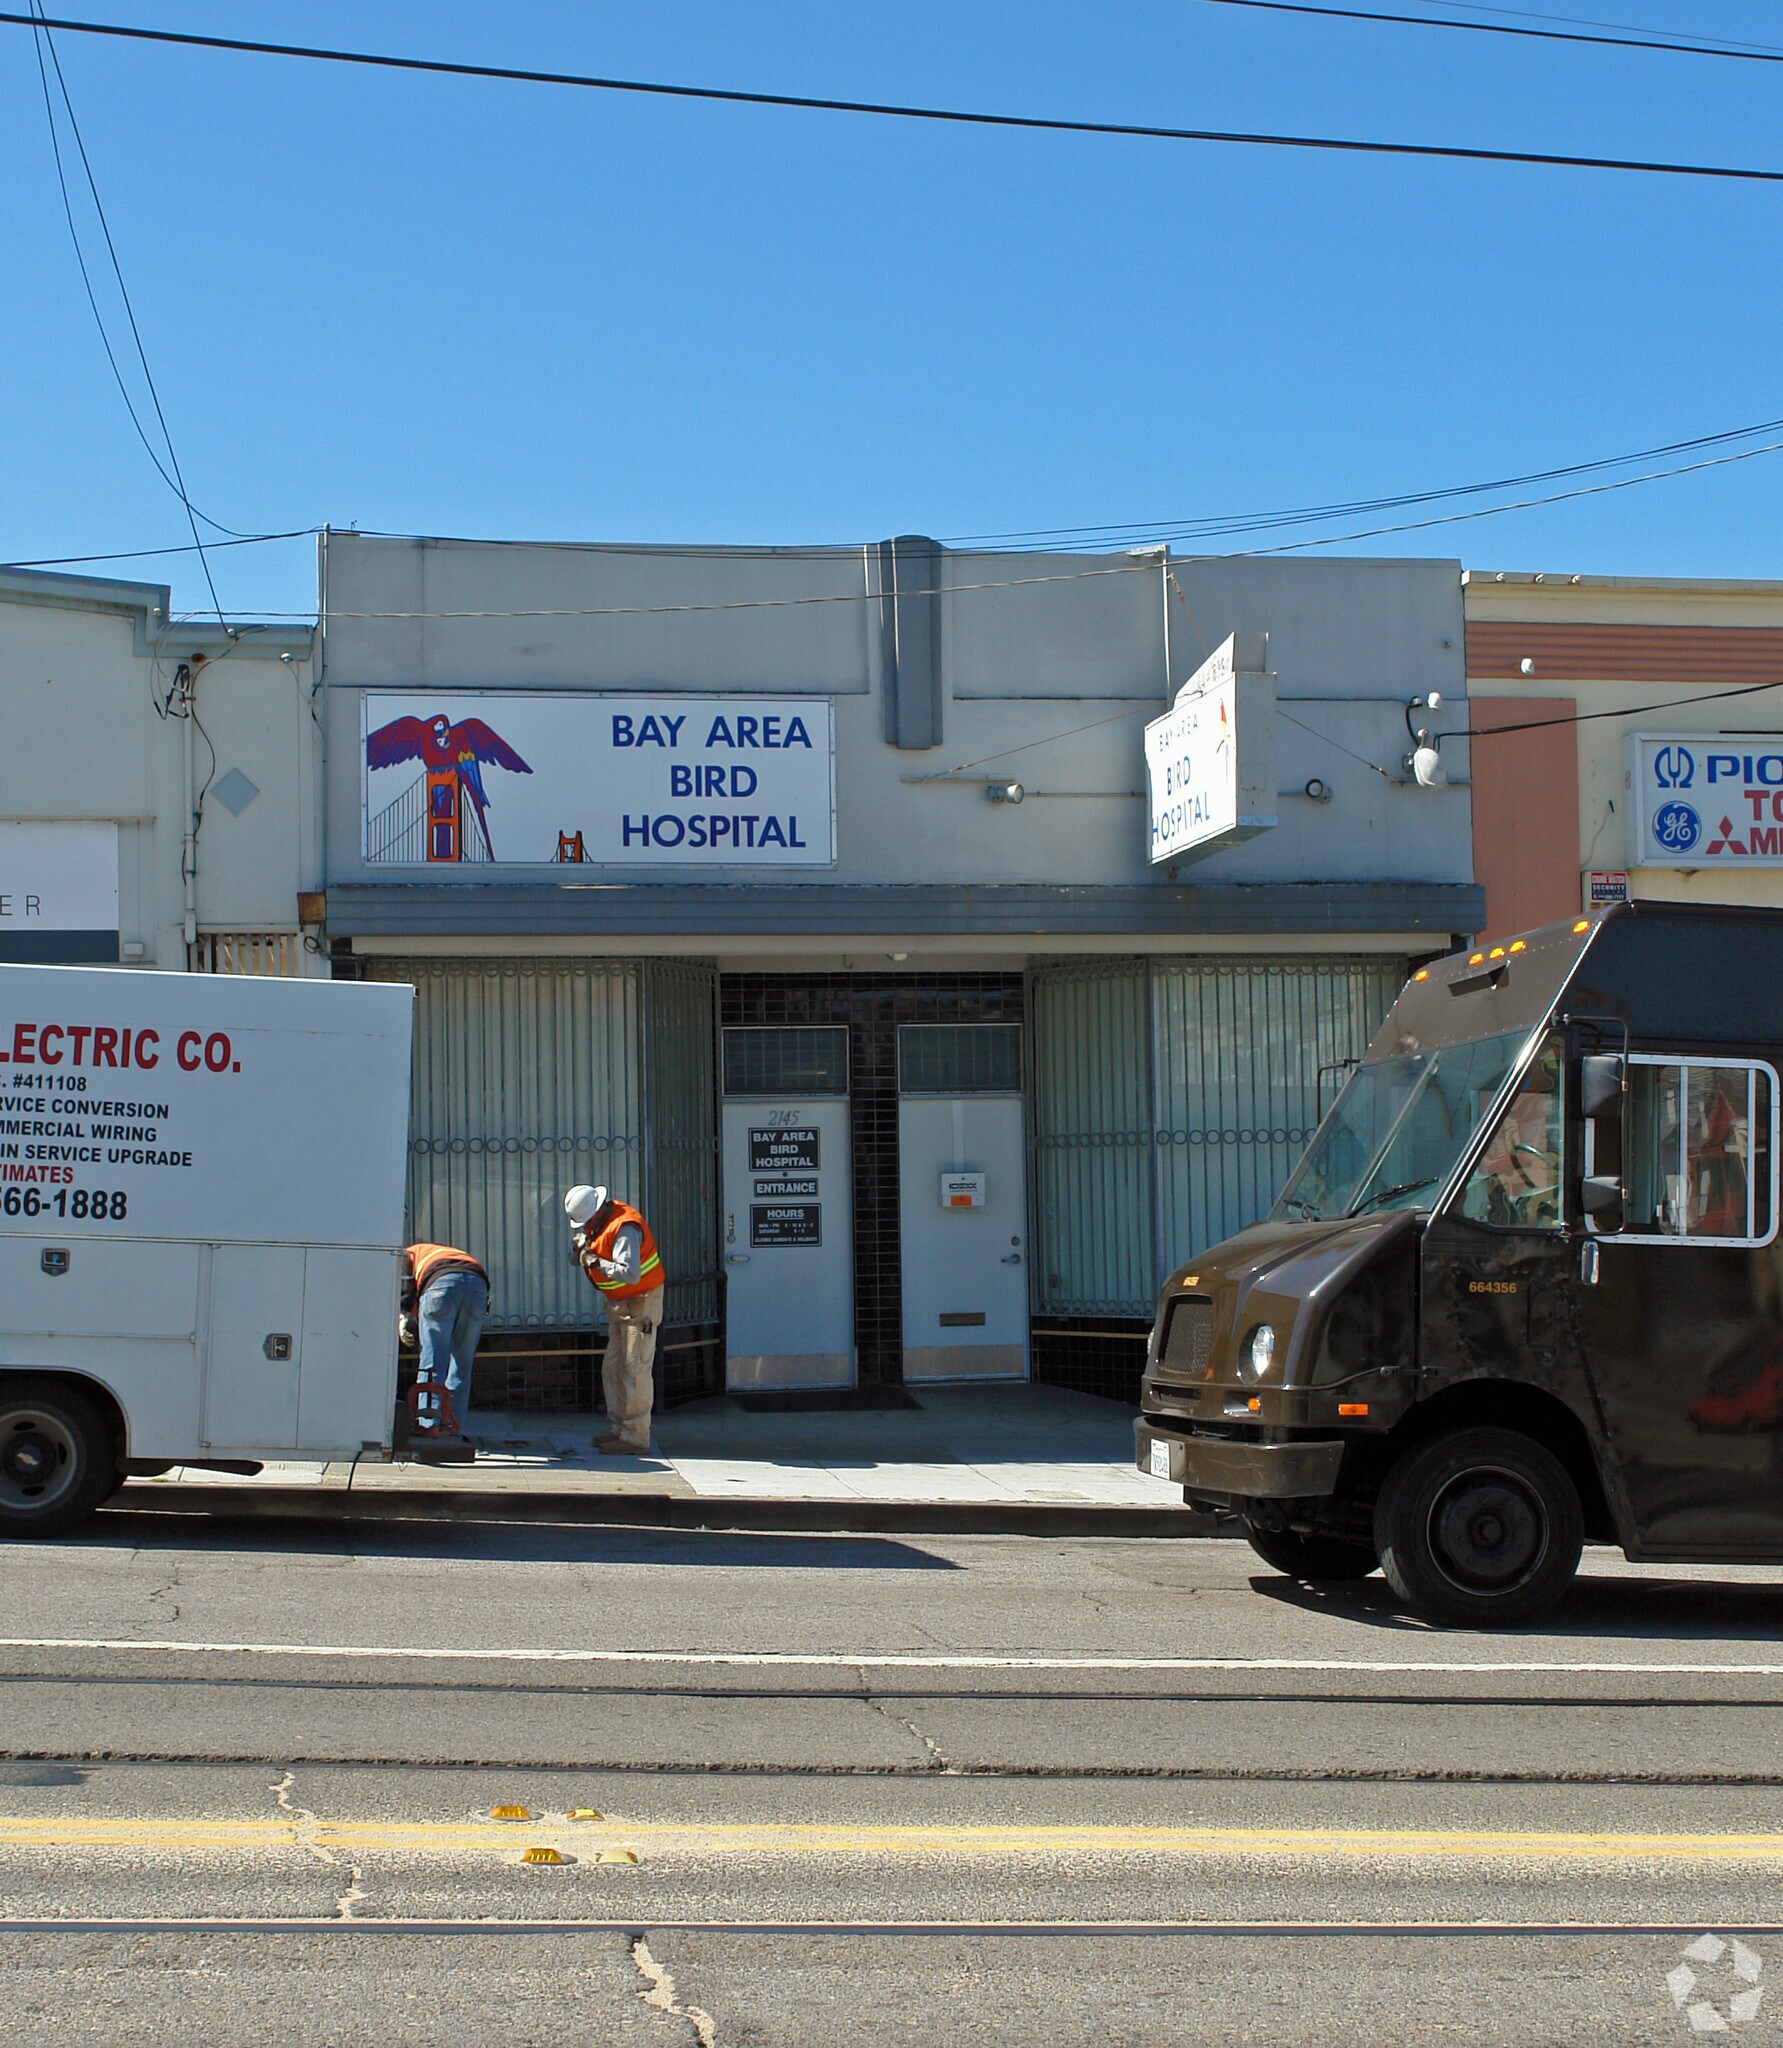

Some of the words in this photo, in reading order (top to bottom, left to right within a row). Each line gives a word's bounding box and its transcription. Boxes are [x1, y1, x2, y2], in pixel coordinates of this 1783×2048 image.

[612, 715, 687, 747] BAY
[705, 716, 813, 748] AREA
[671, 765, 758, 797] BIRD
[1167, 755, 1191, 796] BIRD
[1152, 791, 1210, 846] HOSPITAL
[622, 814, 807, 847] HOSPITAL
[177, 1030, 241, 1073] CO.
[13, 1073, 87, 1092] #411108
[0, 1096, 46, 1112] VICE
[52, 1099, 169, 1119] CONVERSION
[768, 1110, 800, 1126] 2145
[91, 1124, 157, 1142] WIRING
[753, 1132, 776, 1142] BAY
[782, 1131, 815, 1141] AREA
[25, 1144, 102, 1162] SERVICE
[108, 1149, 192, 1167] UPGRADE
[770, 1145, 799, 1154] BIRD
[756, 1156, 814, 1167] HOSPITAL
[756, 1182, 816, 1194] ENTRANCE
[0, 1186, 127, 1220] 66-1888
[767, 1209, 805, 1218] HOURS
[1469, 1281, 1518, 1294] 664356
